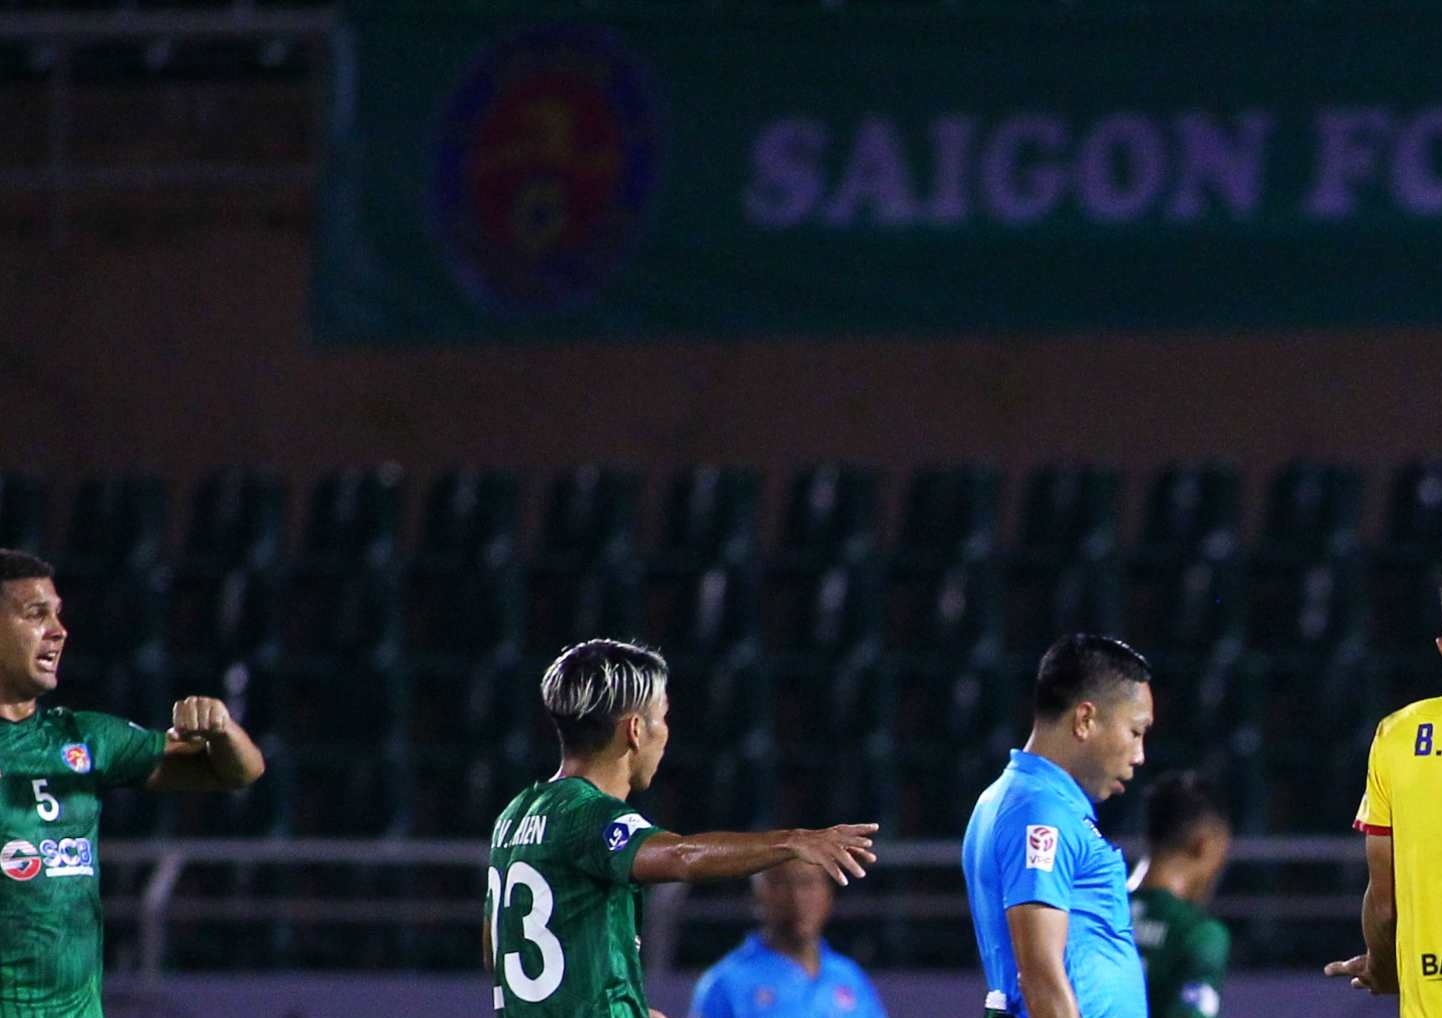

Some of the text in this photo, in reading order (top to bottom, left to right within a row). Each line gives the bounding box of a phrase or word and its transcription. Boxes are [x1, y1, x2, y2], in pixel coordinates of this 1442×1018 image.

[746, 110, 1270, 228] SAIGON
[32, 779, 59, 821] 5
[488, 861, 565, 1010] 23
